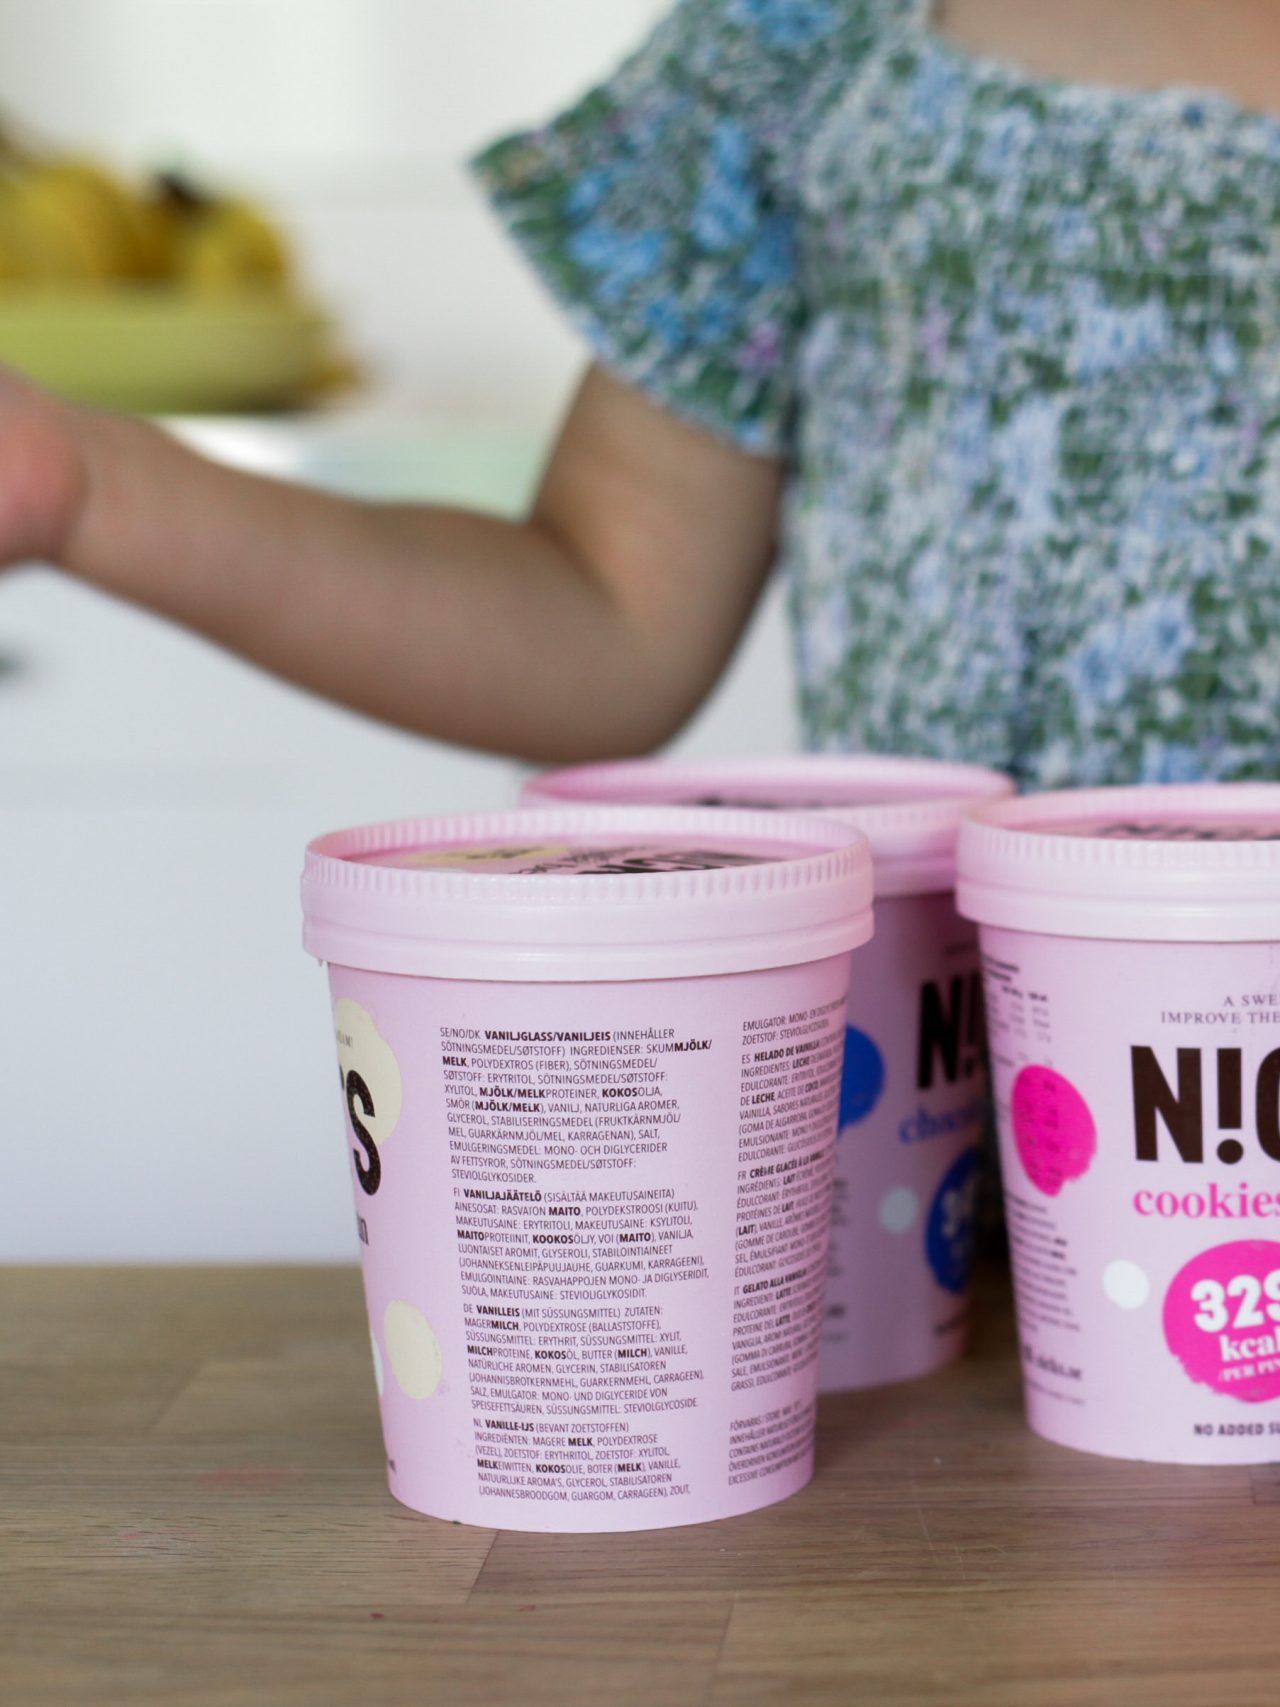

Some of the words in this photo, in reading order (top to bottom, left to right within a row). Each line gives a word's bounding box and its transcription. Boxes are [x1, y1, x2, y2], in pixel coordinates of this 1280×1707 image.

[1223, 996, 1234, 1007] A
[1161, 1010, 1241, 1024] IMPROVE
[1248, 1010, 1280, 1024] THE
[1194, 1423, 1212, 1436] NO
[1218, 1423, 1263, 1436] ADDED
